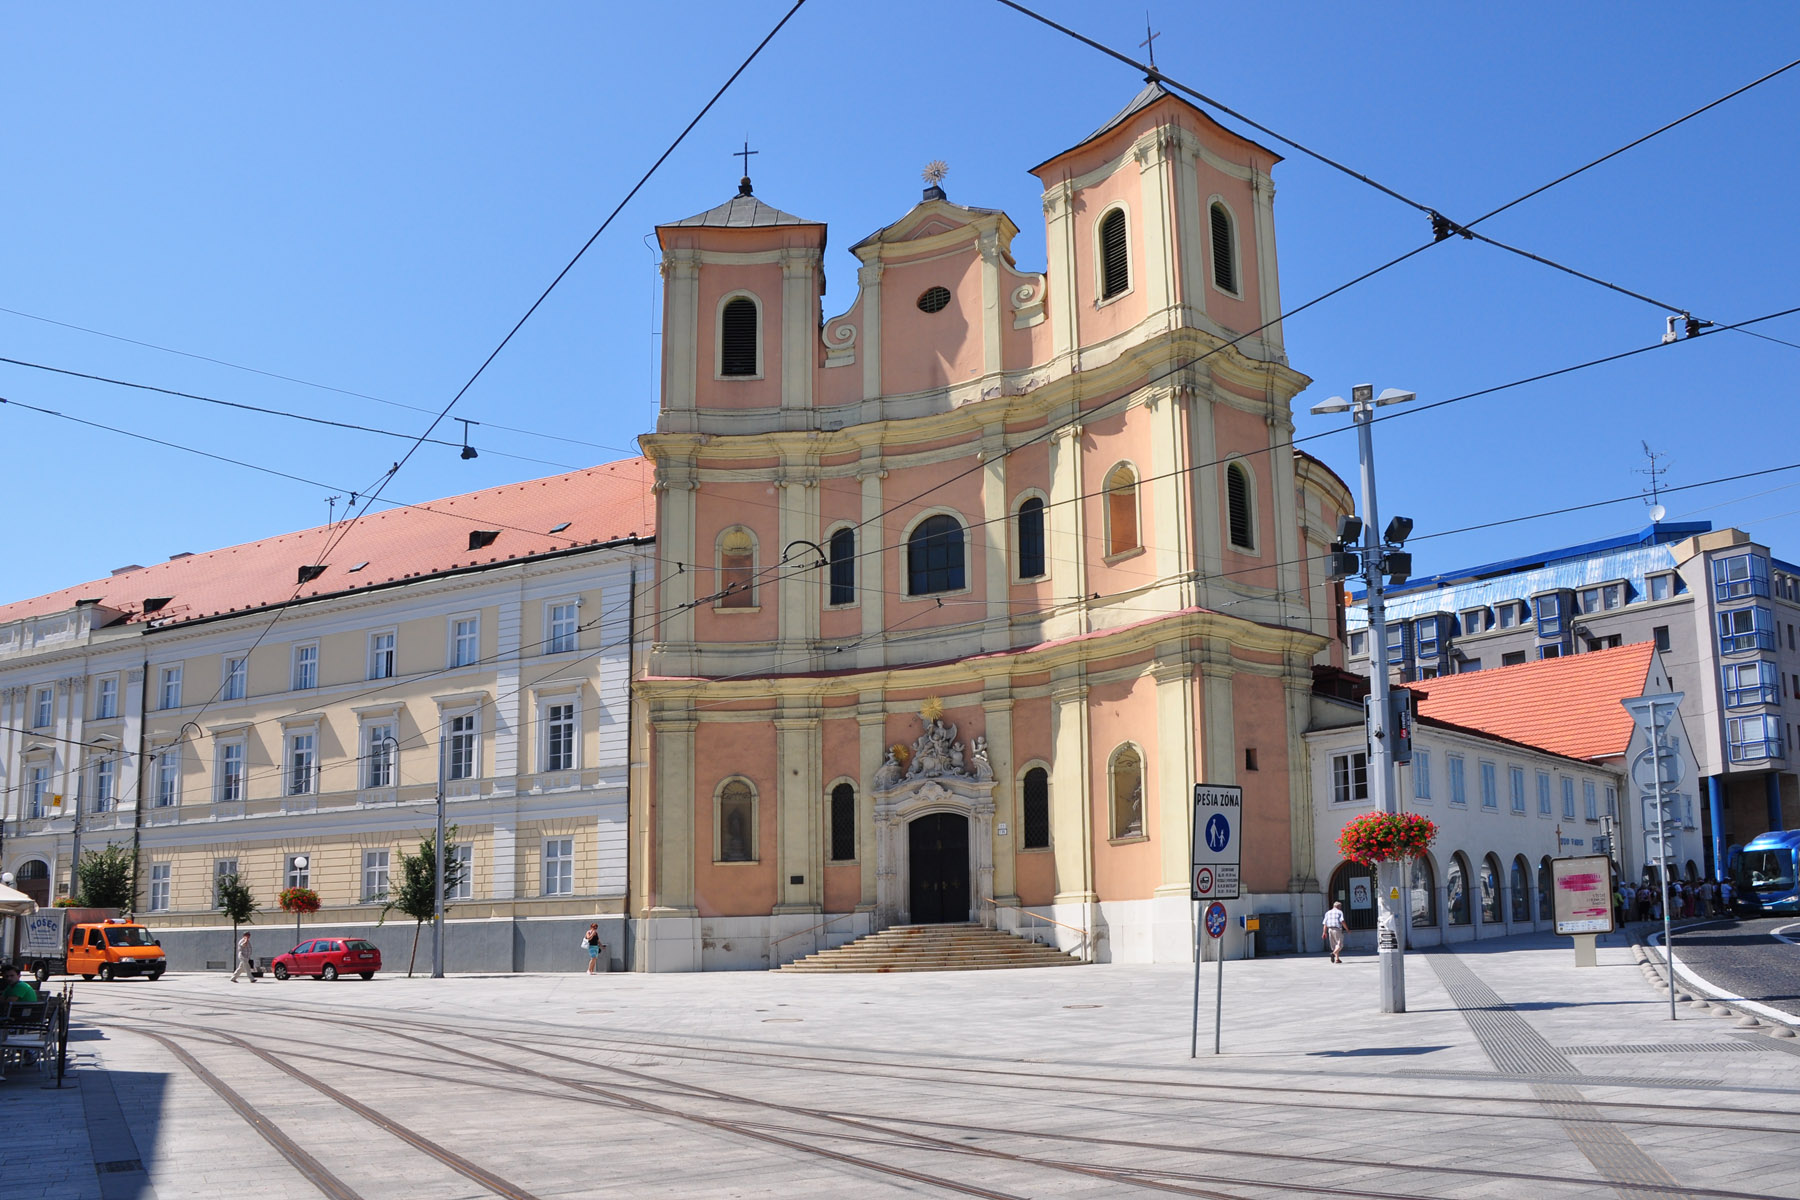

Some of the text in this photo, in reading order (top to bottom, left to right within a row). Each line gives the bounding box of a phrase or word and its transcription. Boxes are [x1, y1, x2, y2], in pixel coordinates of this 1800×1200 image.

[1197, 790, 1239, 807] PEŠIA ZÓNA
[30, 918, 57, 932] KOSEC
